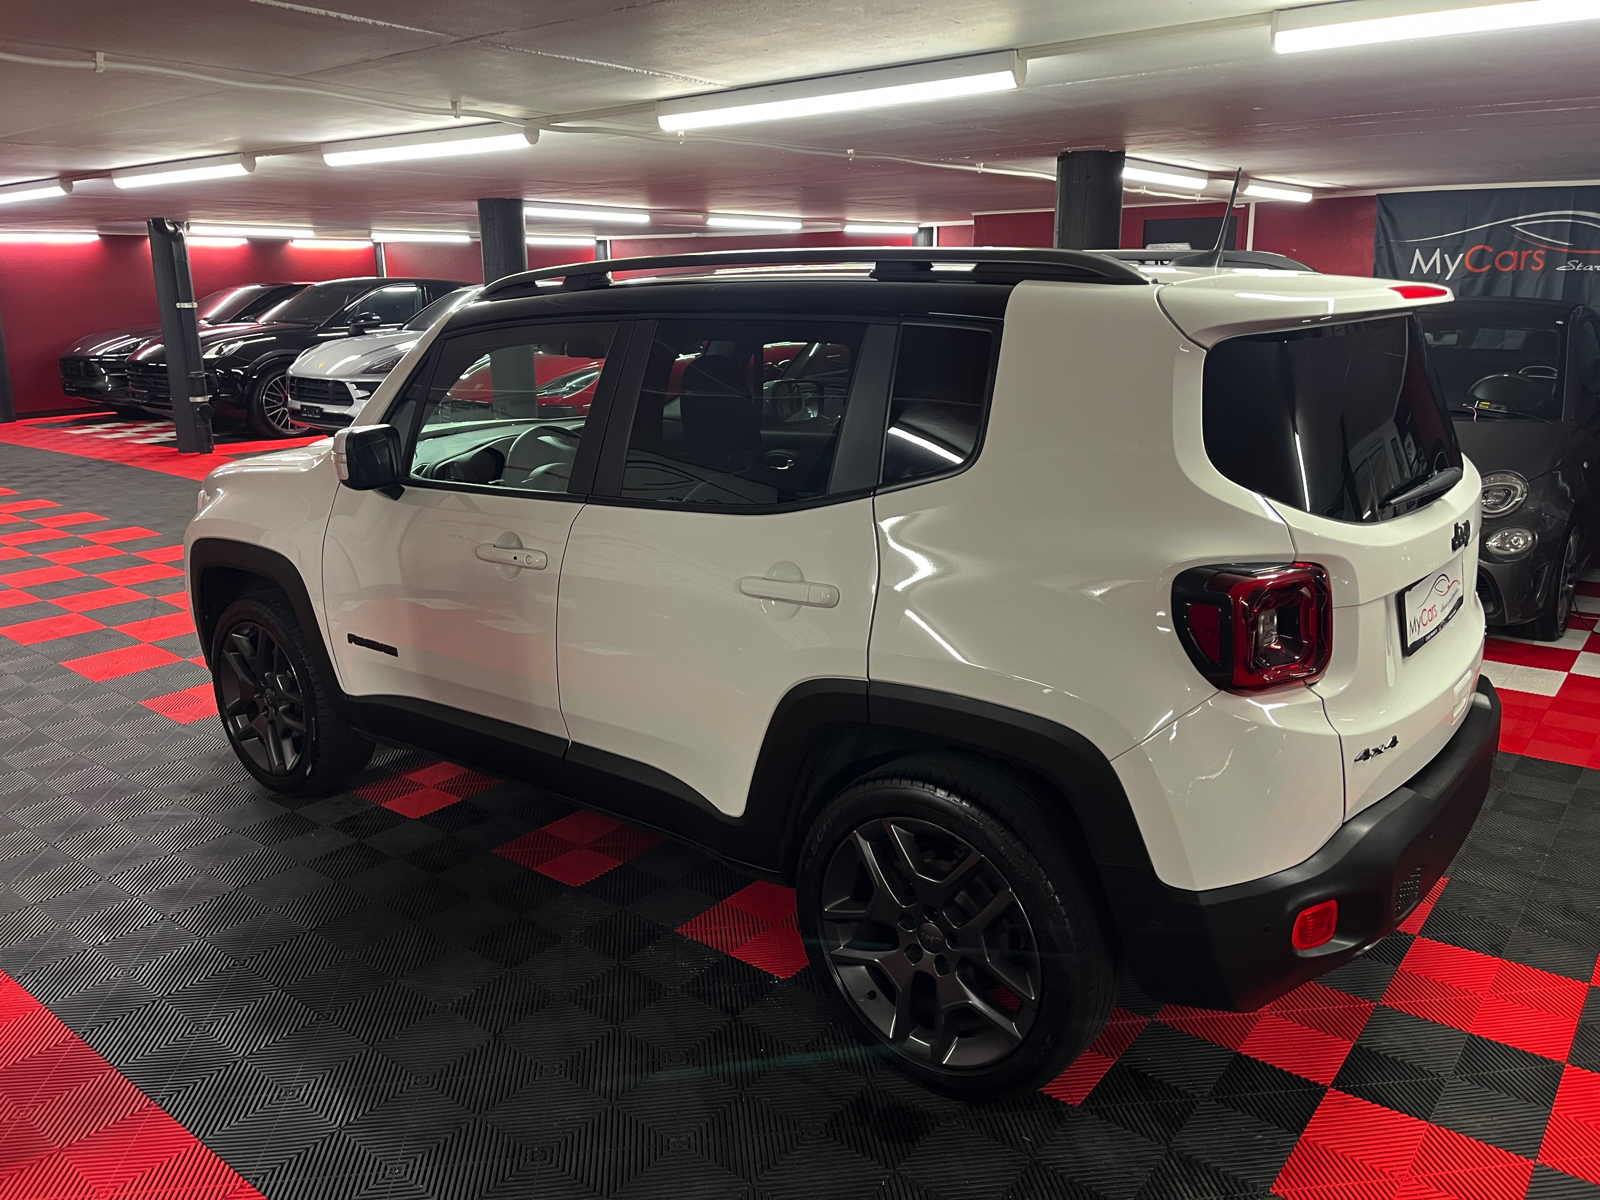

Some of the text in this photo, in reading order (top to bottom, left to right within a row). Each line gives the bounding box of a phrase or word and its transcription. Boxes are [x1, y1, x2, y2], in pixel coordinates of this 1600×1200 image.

[1410, 245, 1546, 280] MyCars
[1409, 604, 1437, 636] MyCars
[1354, 735, 1399, 762] 4x4
